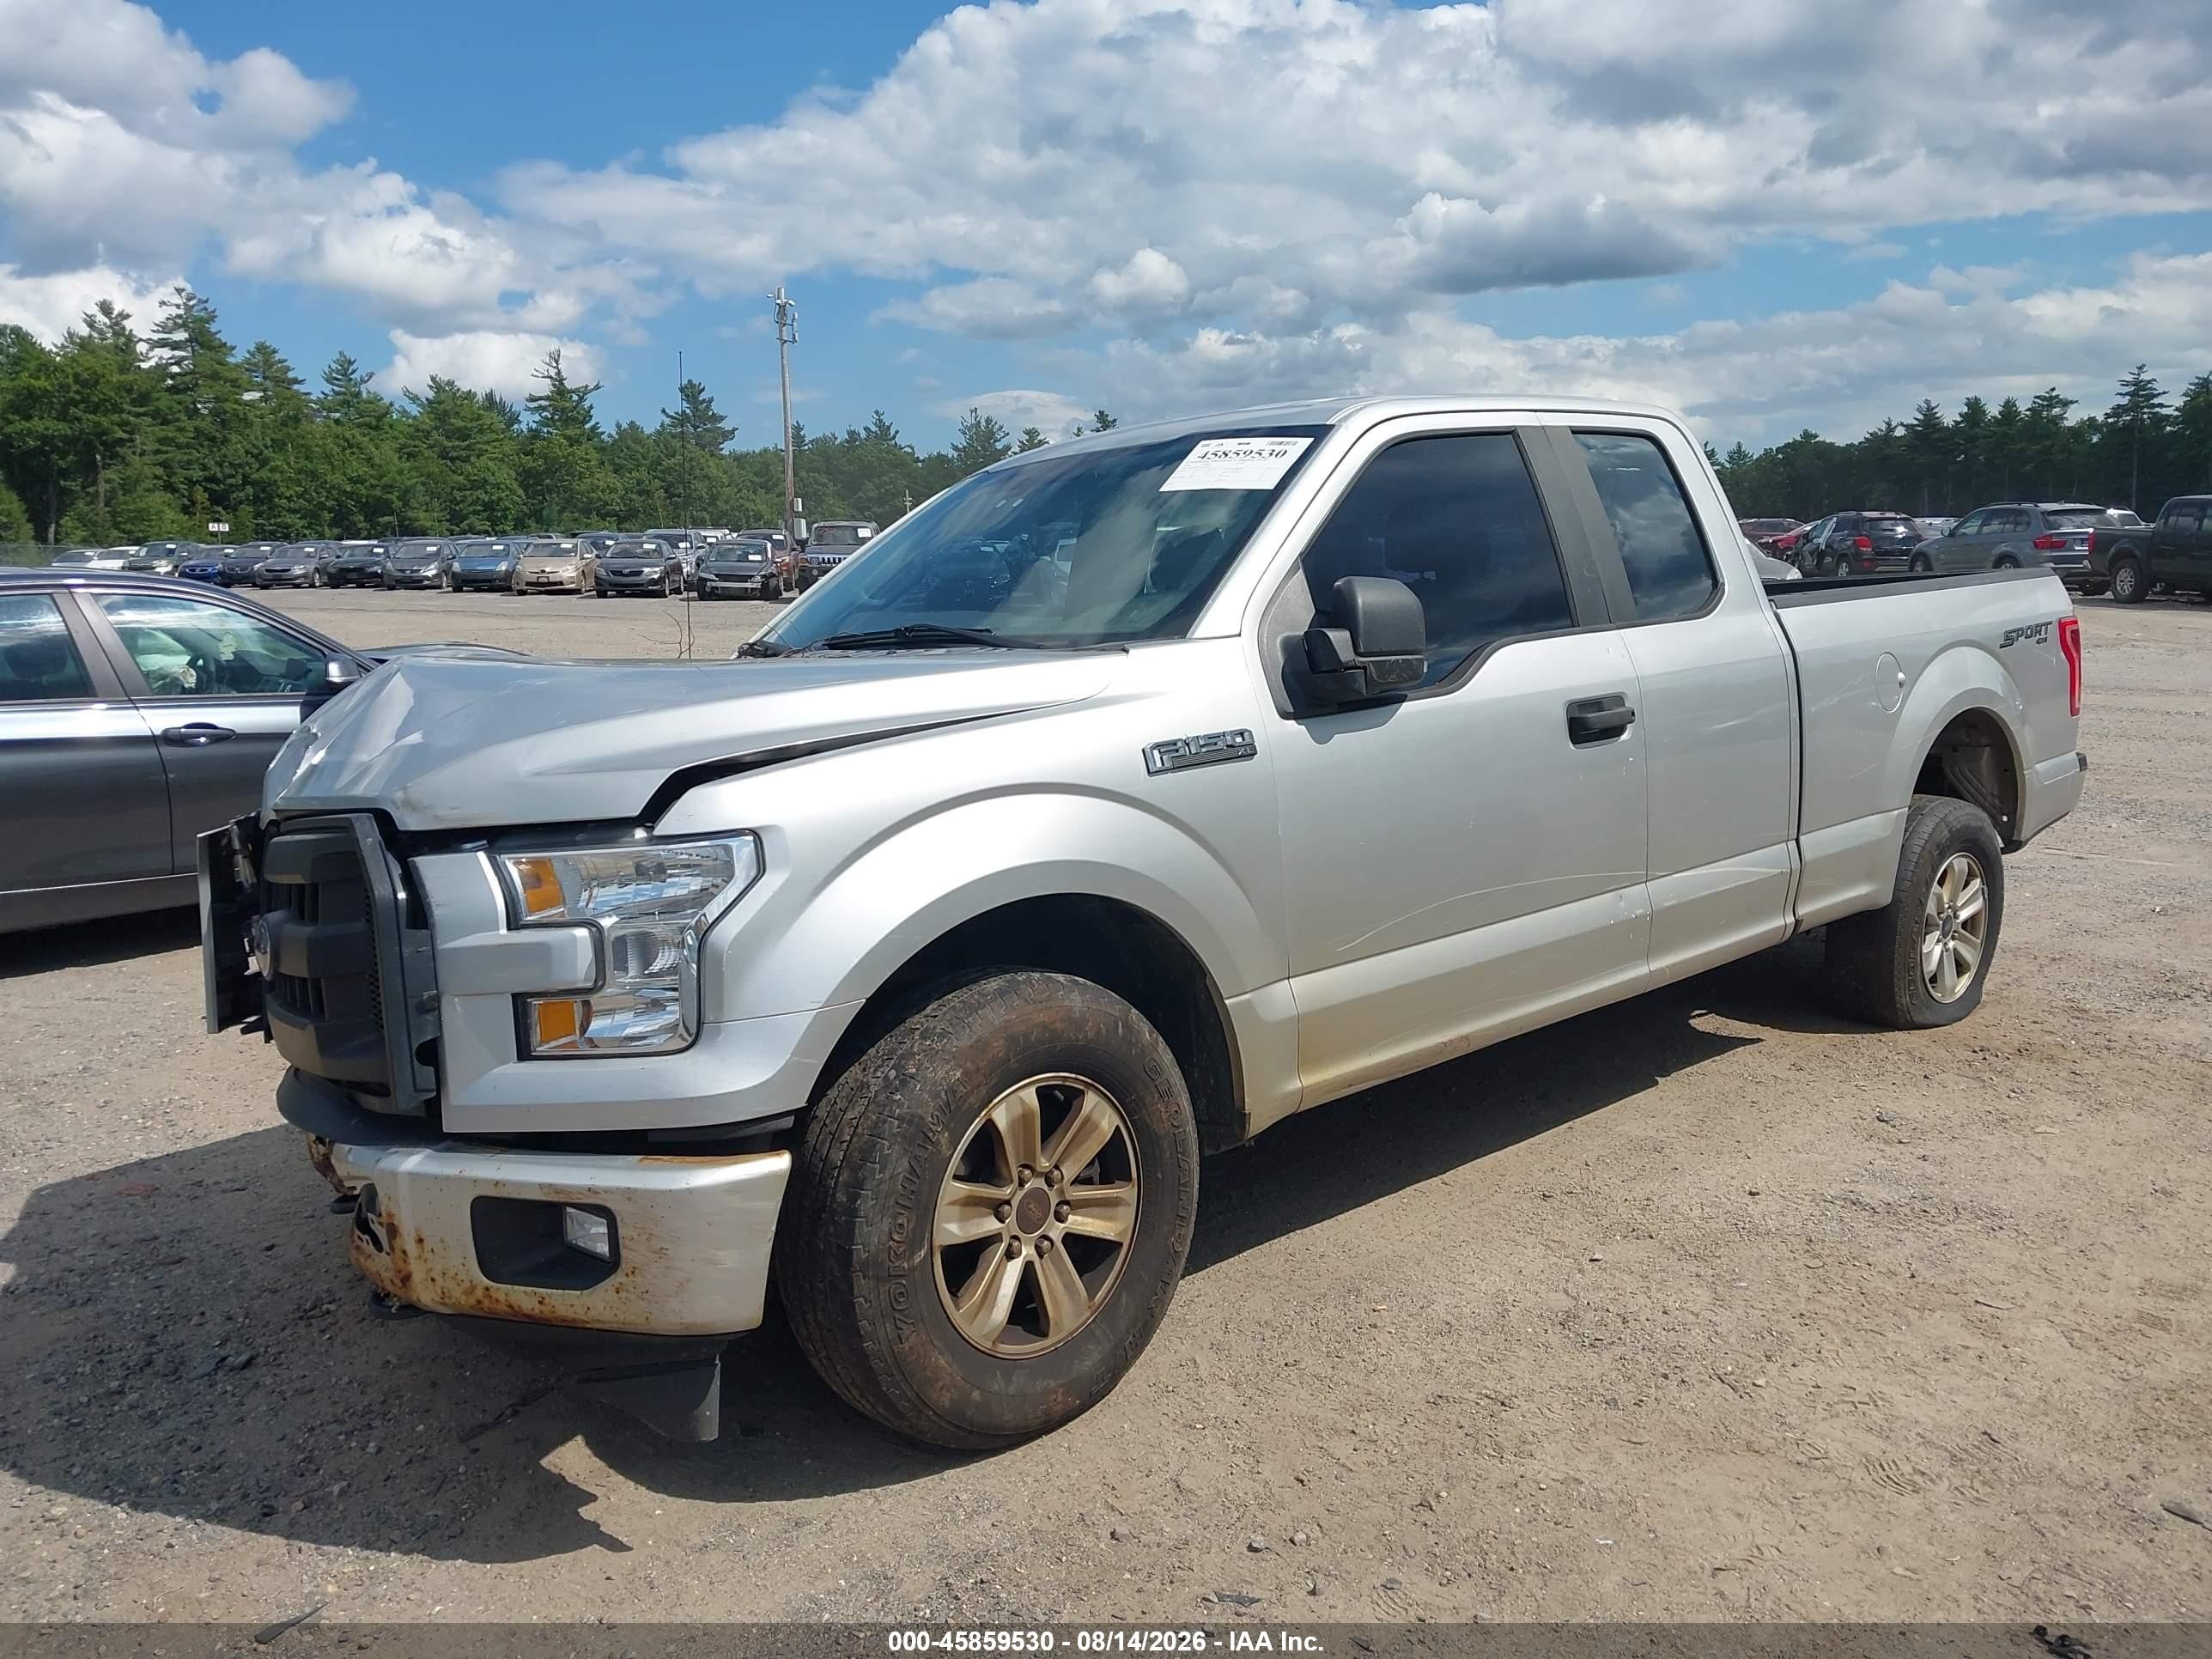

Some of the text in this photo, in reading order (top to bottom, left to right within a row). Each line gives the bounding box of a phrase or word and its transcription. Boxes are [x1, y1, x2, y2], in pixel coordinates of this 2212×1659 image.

[1197, 448, 1288, 459] 45859530
[1999, 620, 2054, 649] SPORT
[887, 1076, 969, 1346] YOKOHAMA
